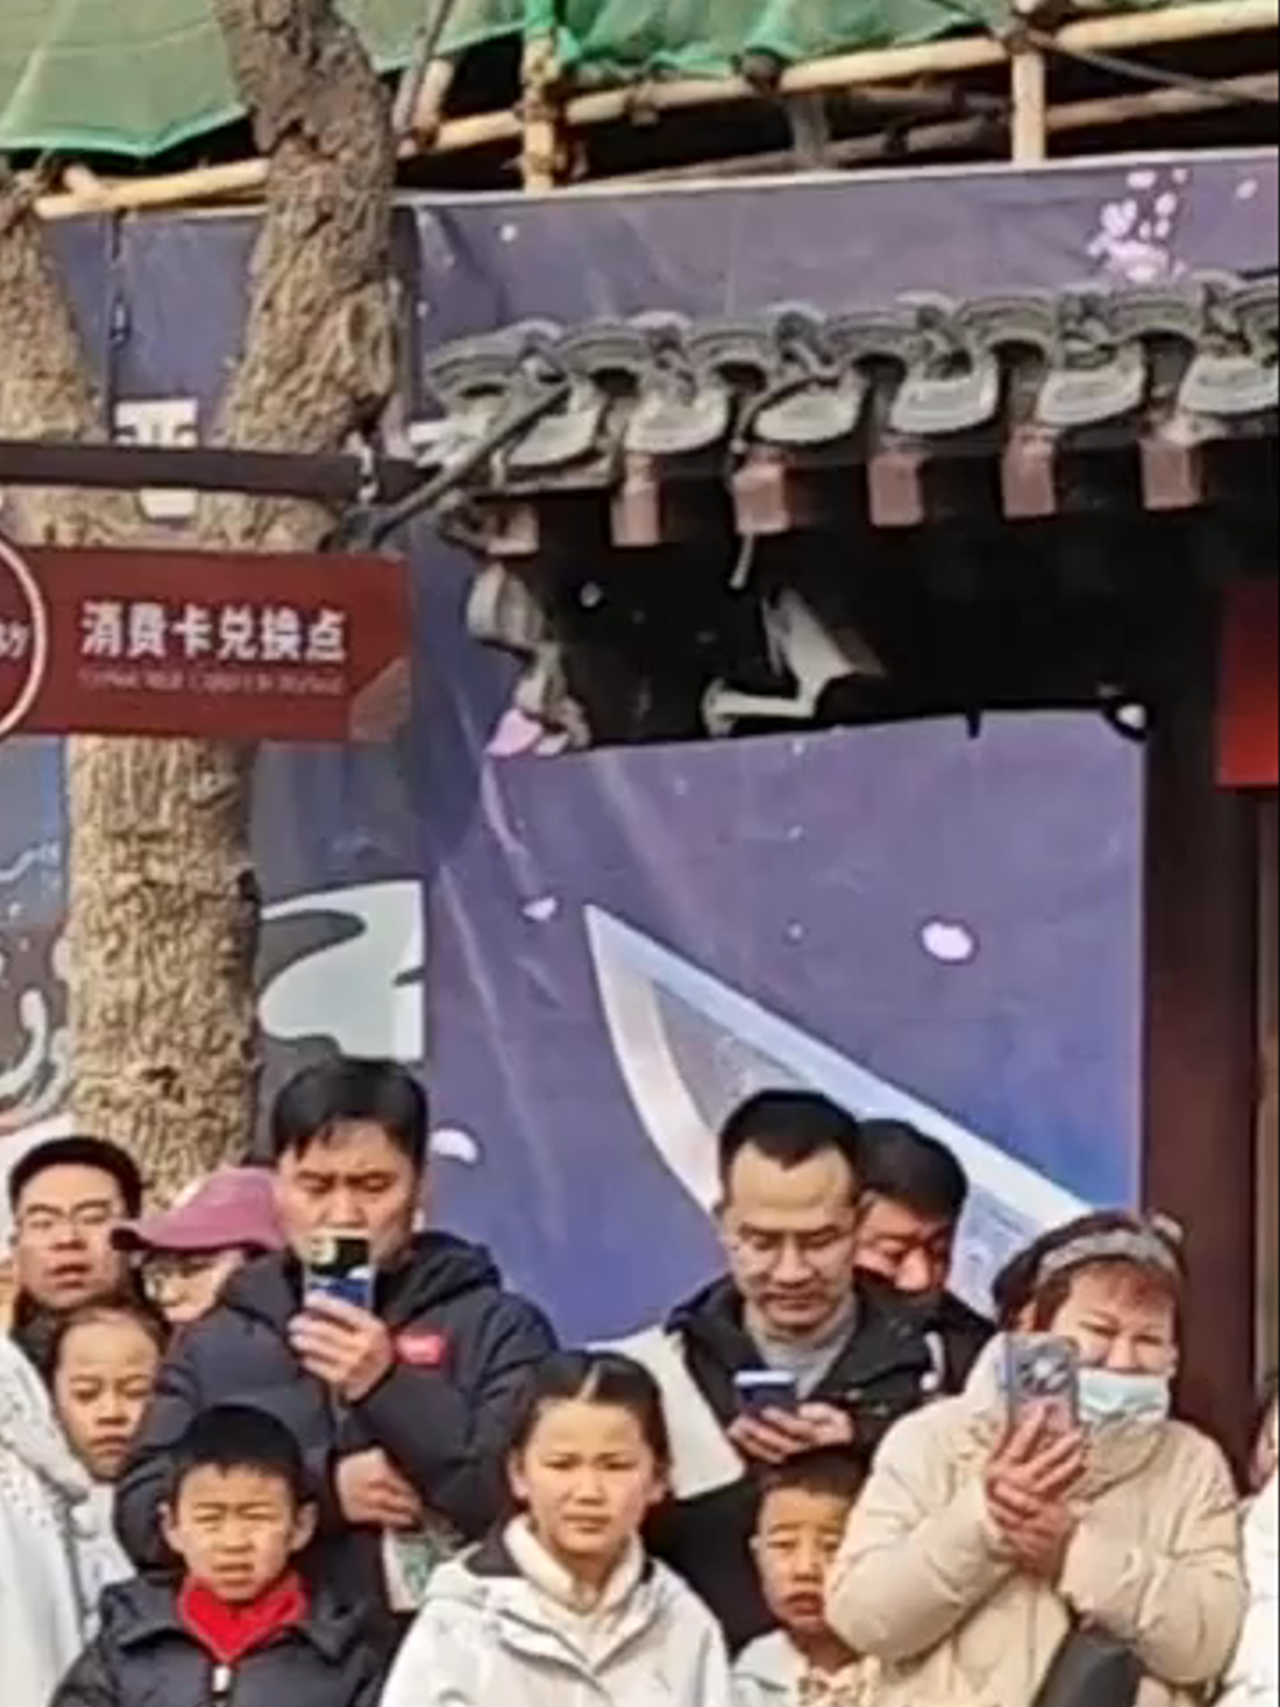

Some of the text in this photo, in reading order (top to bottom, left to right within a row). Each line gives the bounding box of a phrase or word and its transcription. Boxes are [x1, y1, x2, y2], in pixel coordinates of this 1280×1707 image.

[80, 601, 347, 662] 消费卡兑换点
